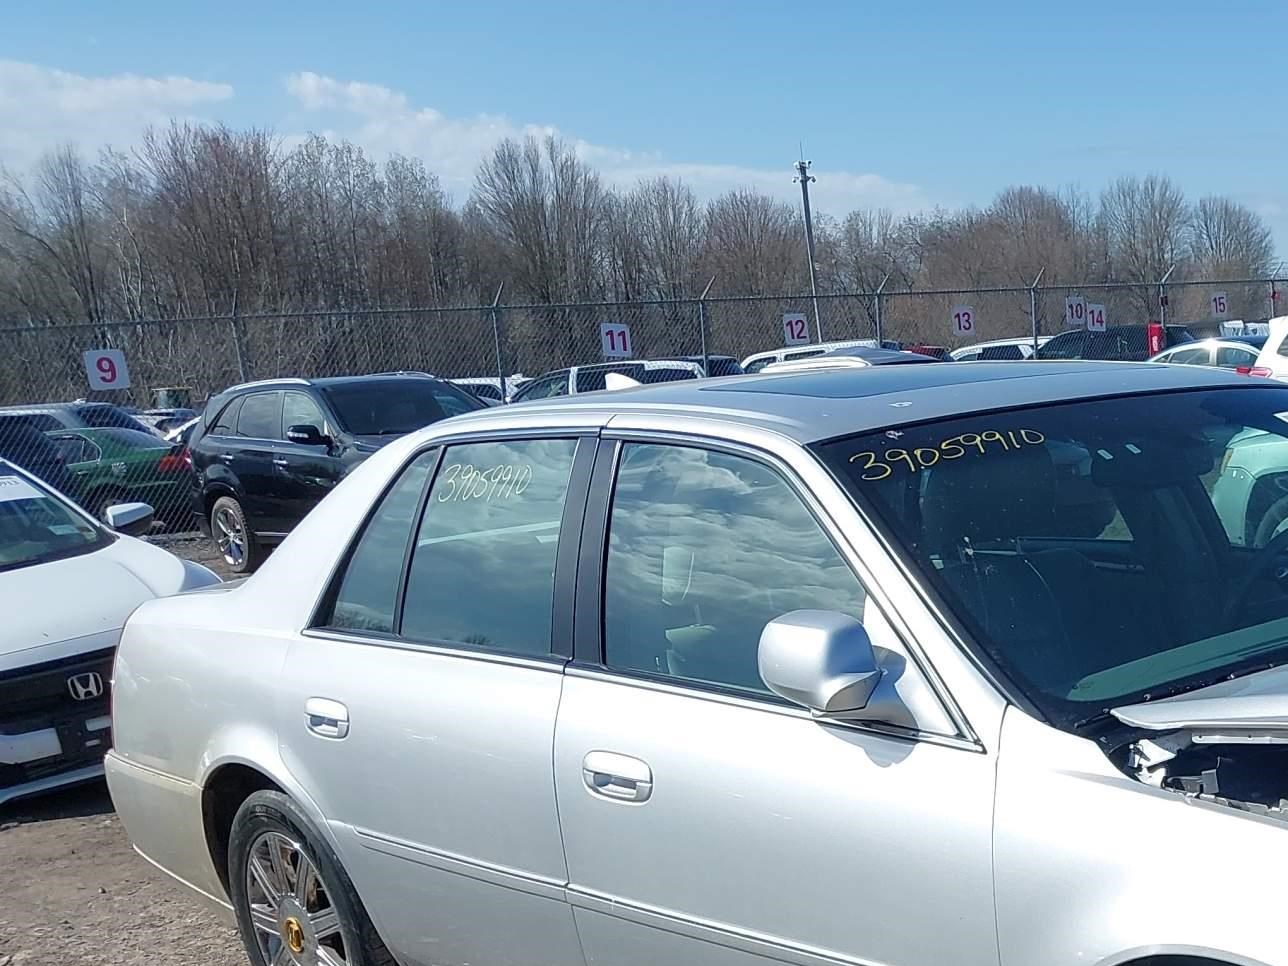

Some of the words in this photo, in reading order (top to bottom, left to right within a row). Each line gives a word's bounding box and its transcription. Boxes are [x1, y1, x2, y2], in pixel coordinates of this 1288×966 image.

[1068, 303, 1083, 319] 10
[1212, 296, 1226, 313] 15
[954, 312, 972, 331] 13
[1089, 309, 1104, 327] 14
[786, 319, 807, 340] 12
[605, 329, 628, 352] 11
[96, 356, 117, 383] 9
[849, 429, 1046, 481] 39059910
[438, 464, 533, 503] 39059910
